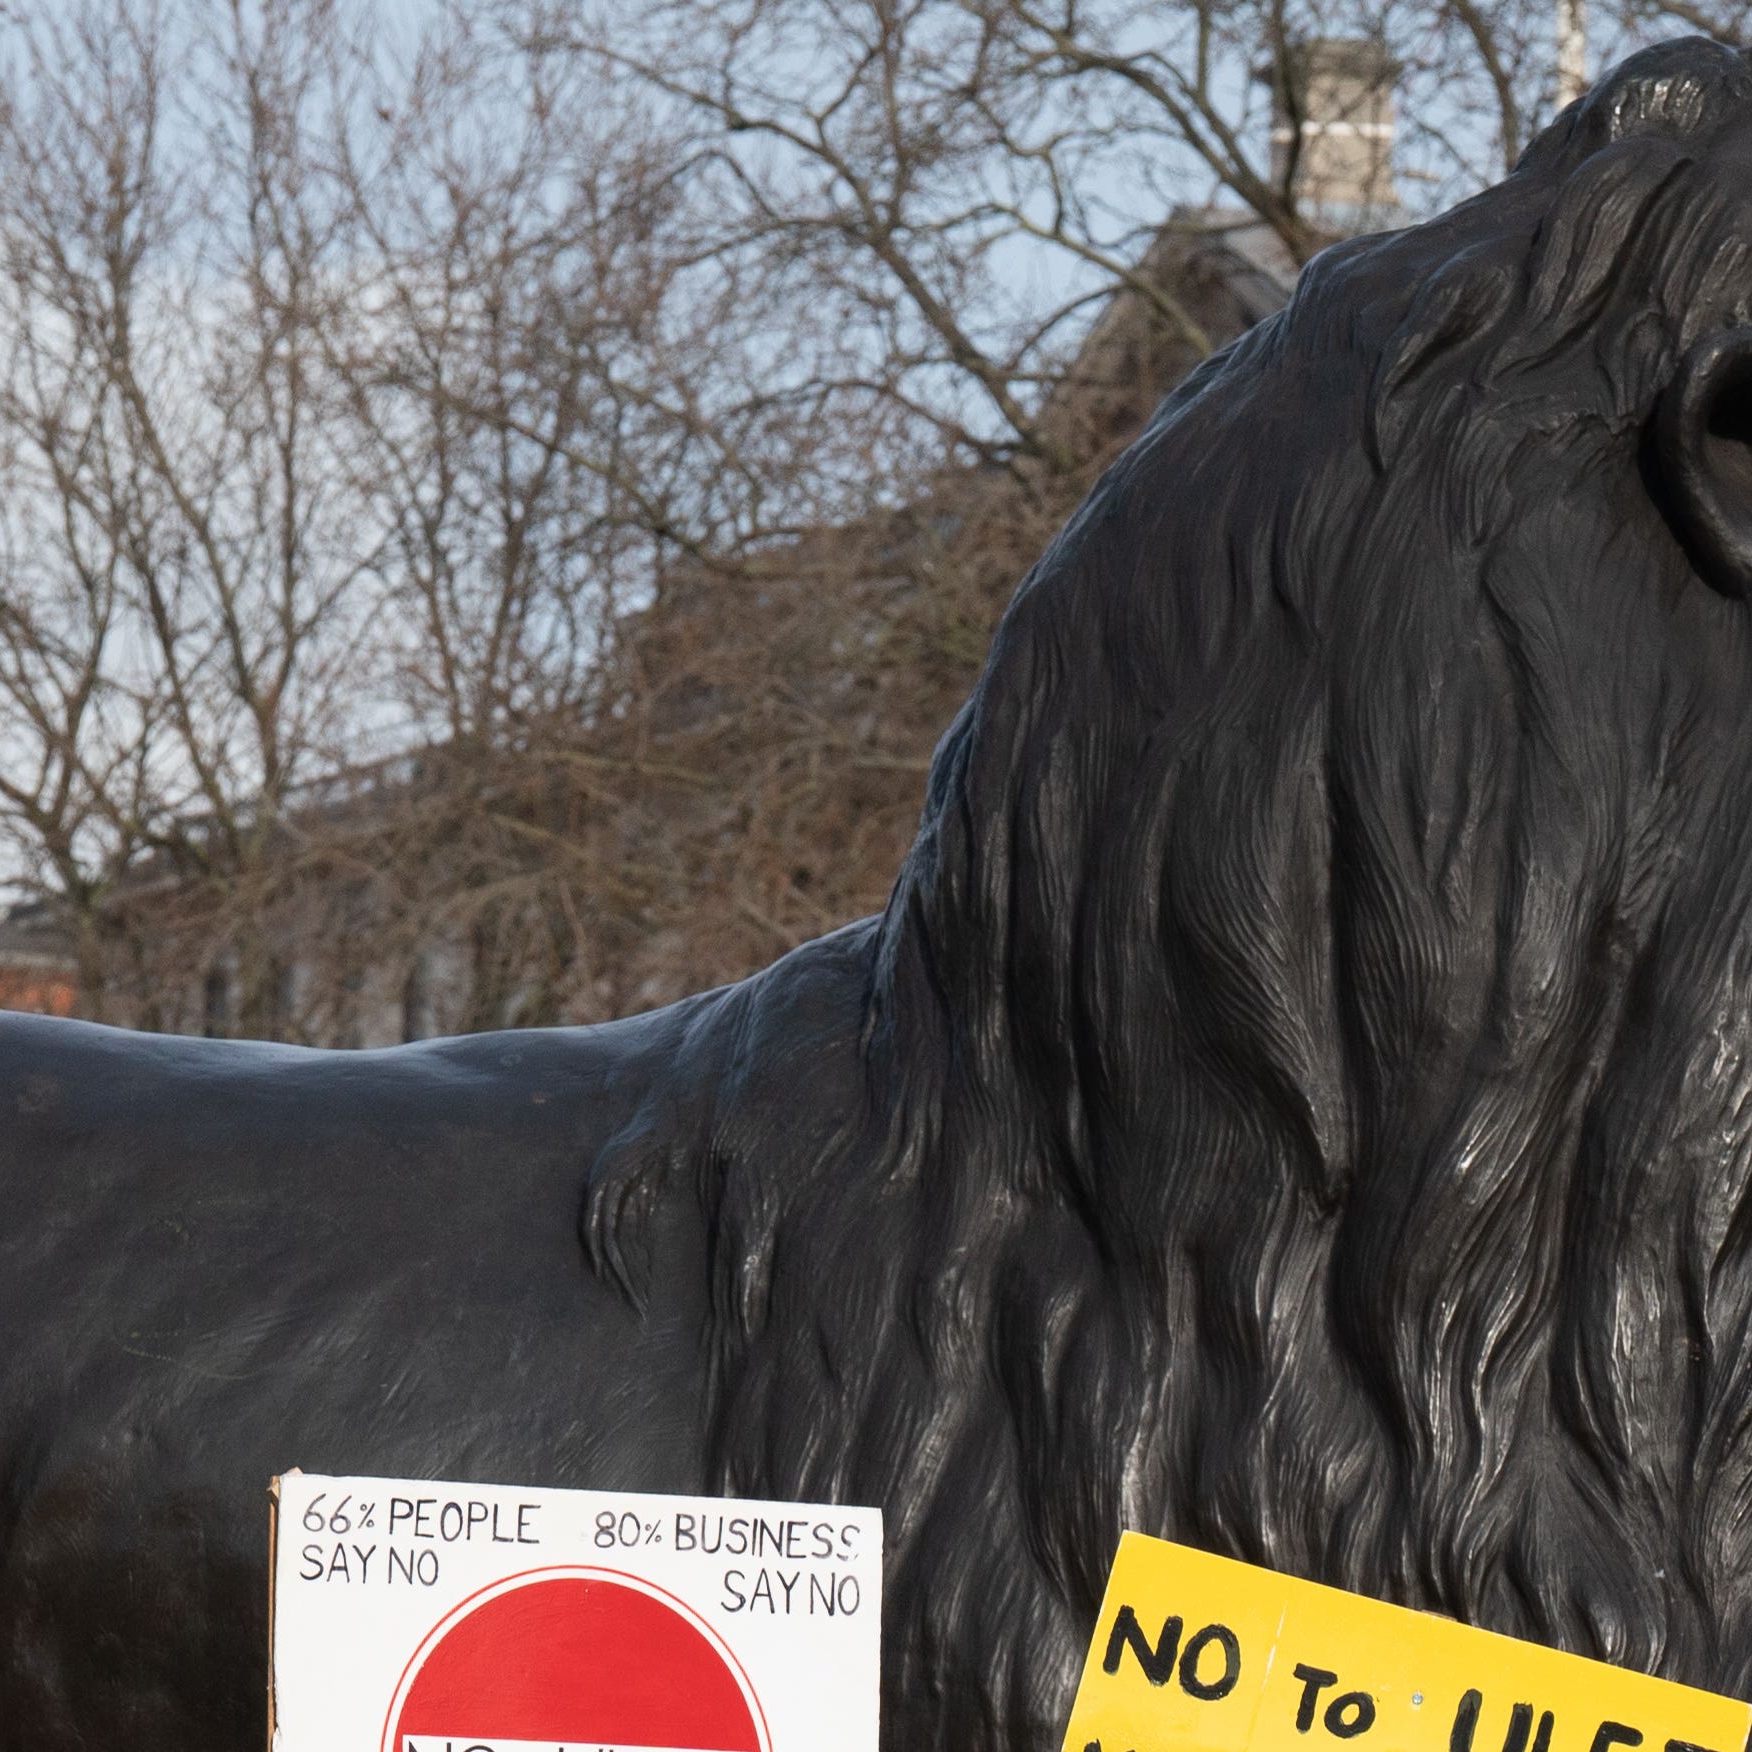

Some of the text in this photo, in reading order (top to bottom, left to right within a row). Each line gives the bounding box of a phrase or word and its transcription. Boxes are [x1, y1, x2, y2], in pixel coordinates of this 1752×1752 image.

[302, 1494, 542, 1544] 66% PEOPLE
[594, 1511, 862, 1561] 80% BUSINESS
[298, 1544, 439, 1586] SAY NO
[720, 1567, 861, 1617] SAY NO
[1103, 1603, 1241, 1700] NO
